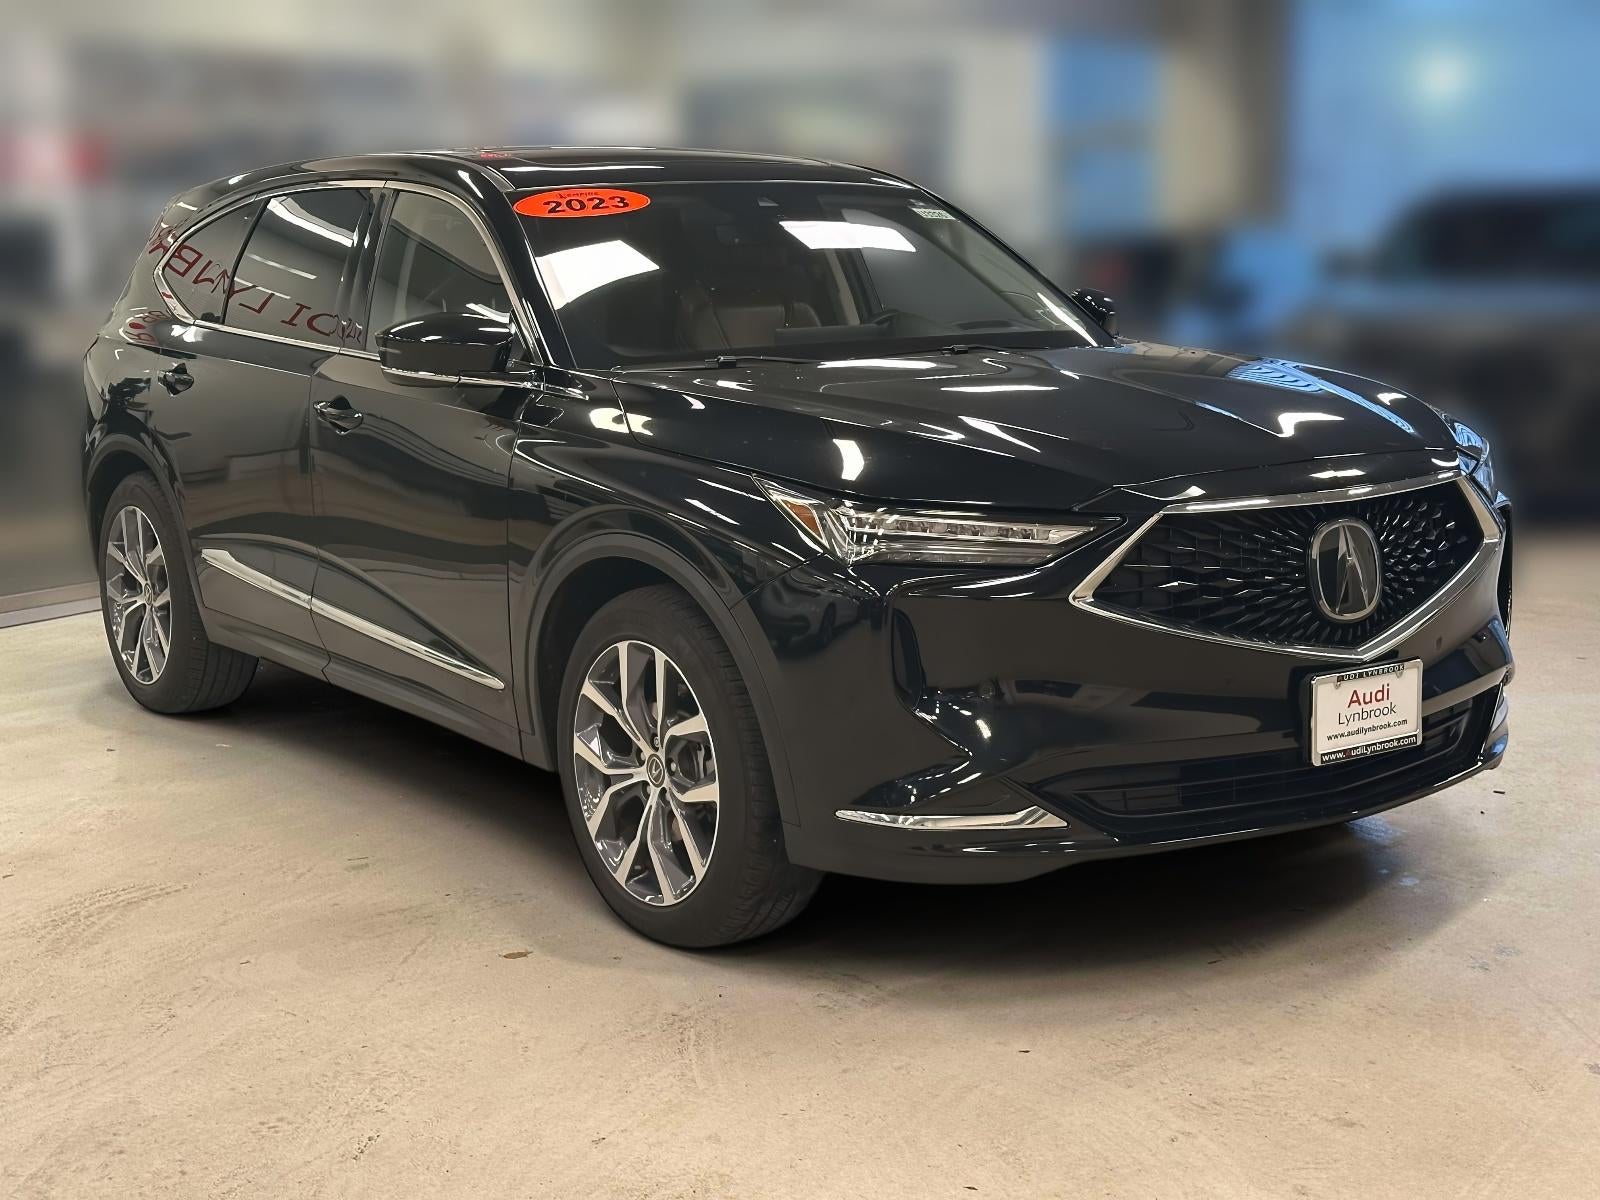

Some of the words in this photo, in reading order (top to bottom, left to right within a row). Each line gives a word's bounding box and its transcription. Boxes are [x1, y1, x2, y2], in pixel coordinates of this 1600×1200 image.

[543, 195, 630, 214] 2023
[1363, 665, 1404, 678] LYNBROOK
[1347, 683, 1390, 708] Audi
[1338, 702, 1397, 726] Lynbrook
[1327, 718, 1408, 741] www.audilynbrook.com
